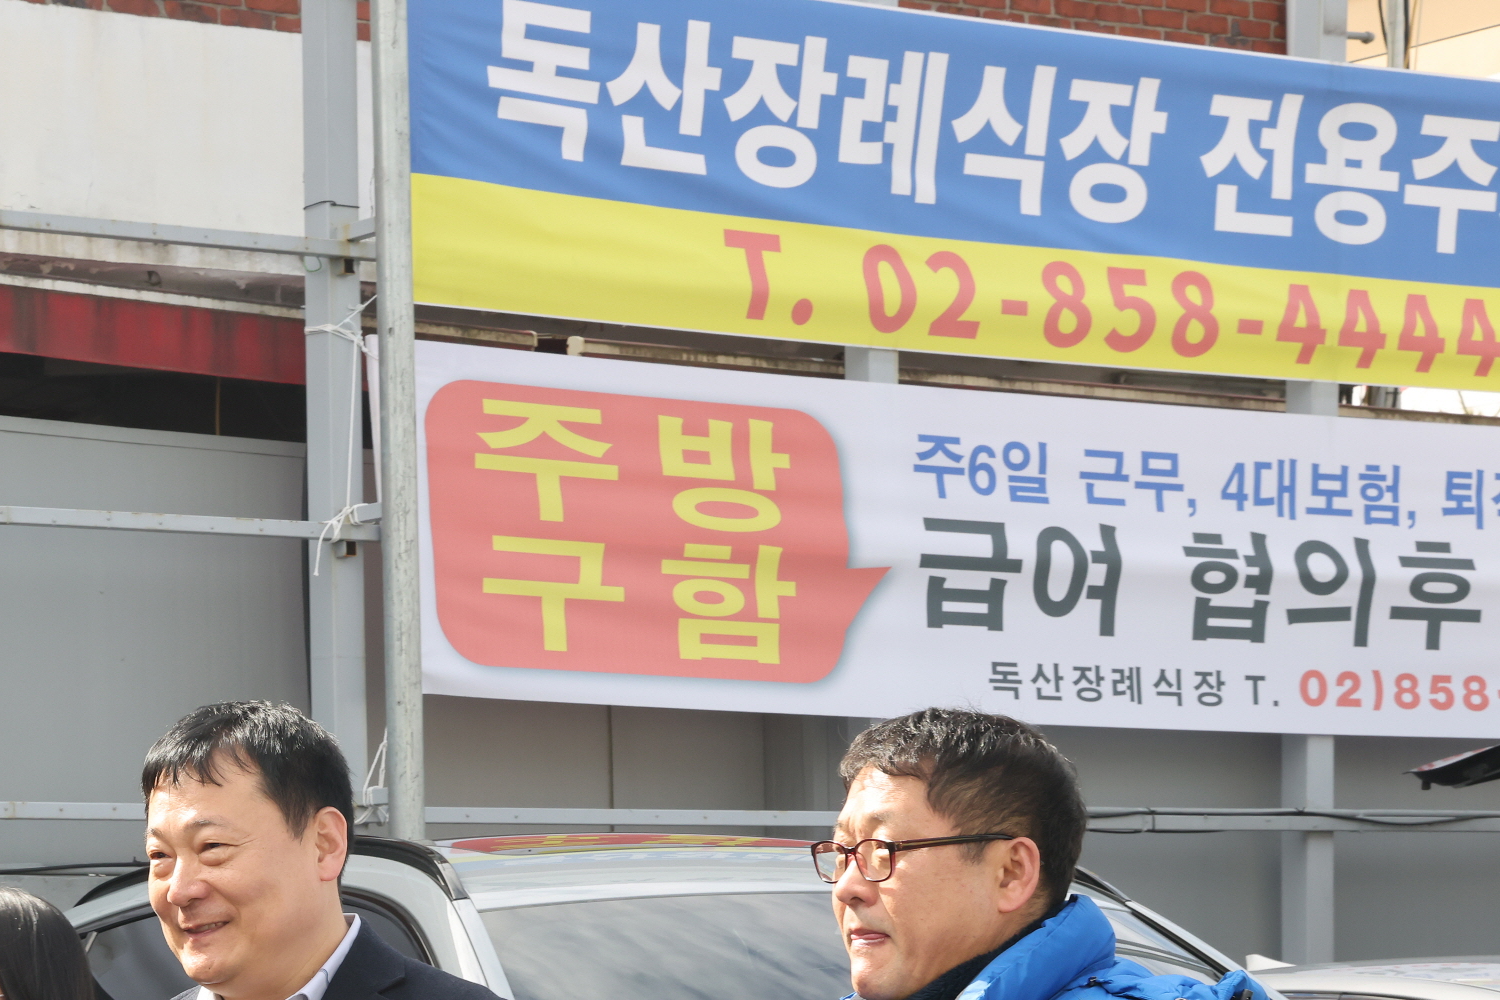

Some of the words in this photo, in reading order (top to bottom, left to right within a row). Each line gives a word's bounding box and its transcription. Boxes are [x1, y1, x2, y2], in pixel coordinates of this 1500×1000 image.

[487, 0, 1168, 224] 독산장례식장
[1200, 93, 1500, 254] 전용주
[723, 228, 814, 326] T.
[862, 244, 1500, 377] 02-858-4444
[475, 398, 791, 533] 주방
[913, 434, 1050, 505] 주6일
[1079, 449, 1197, 517] 근무,
[1221, 458, 1416, 529] 4대보험,
[1442, 469, 1500, 530] 퇴
[483, 529, 796, 665] 구함
[919, 517, 1122, 637] 급여
[1183, 532, 1482, 651] 협의후
[989, 661, 1225, 707] 독산장례식장
[1245, 675, 1280, 708] T.
[1300, 669, 1500, 712] 02)858
